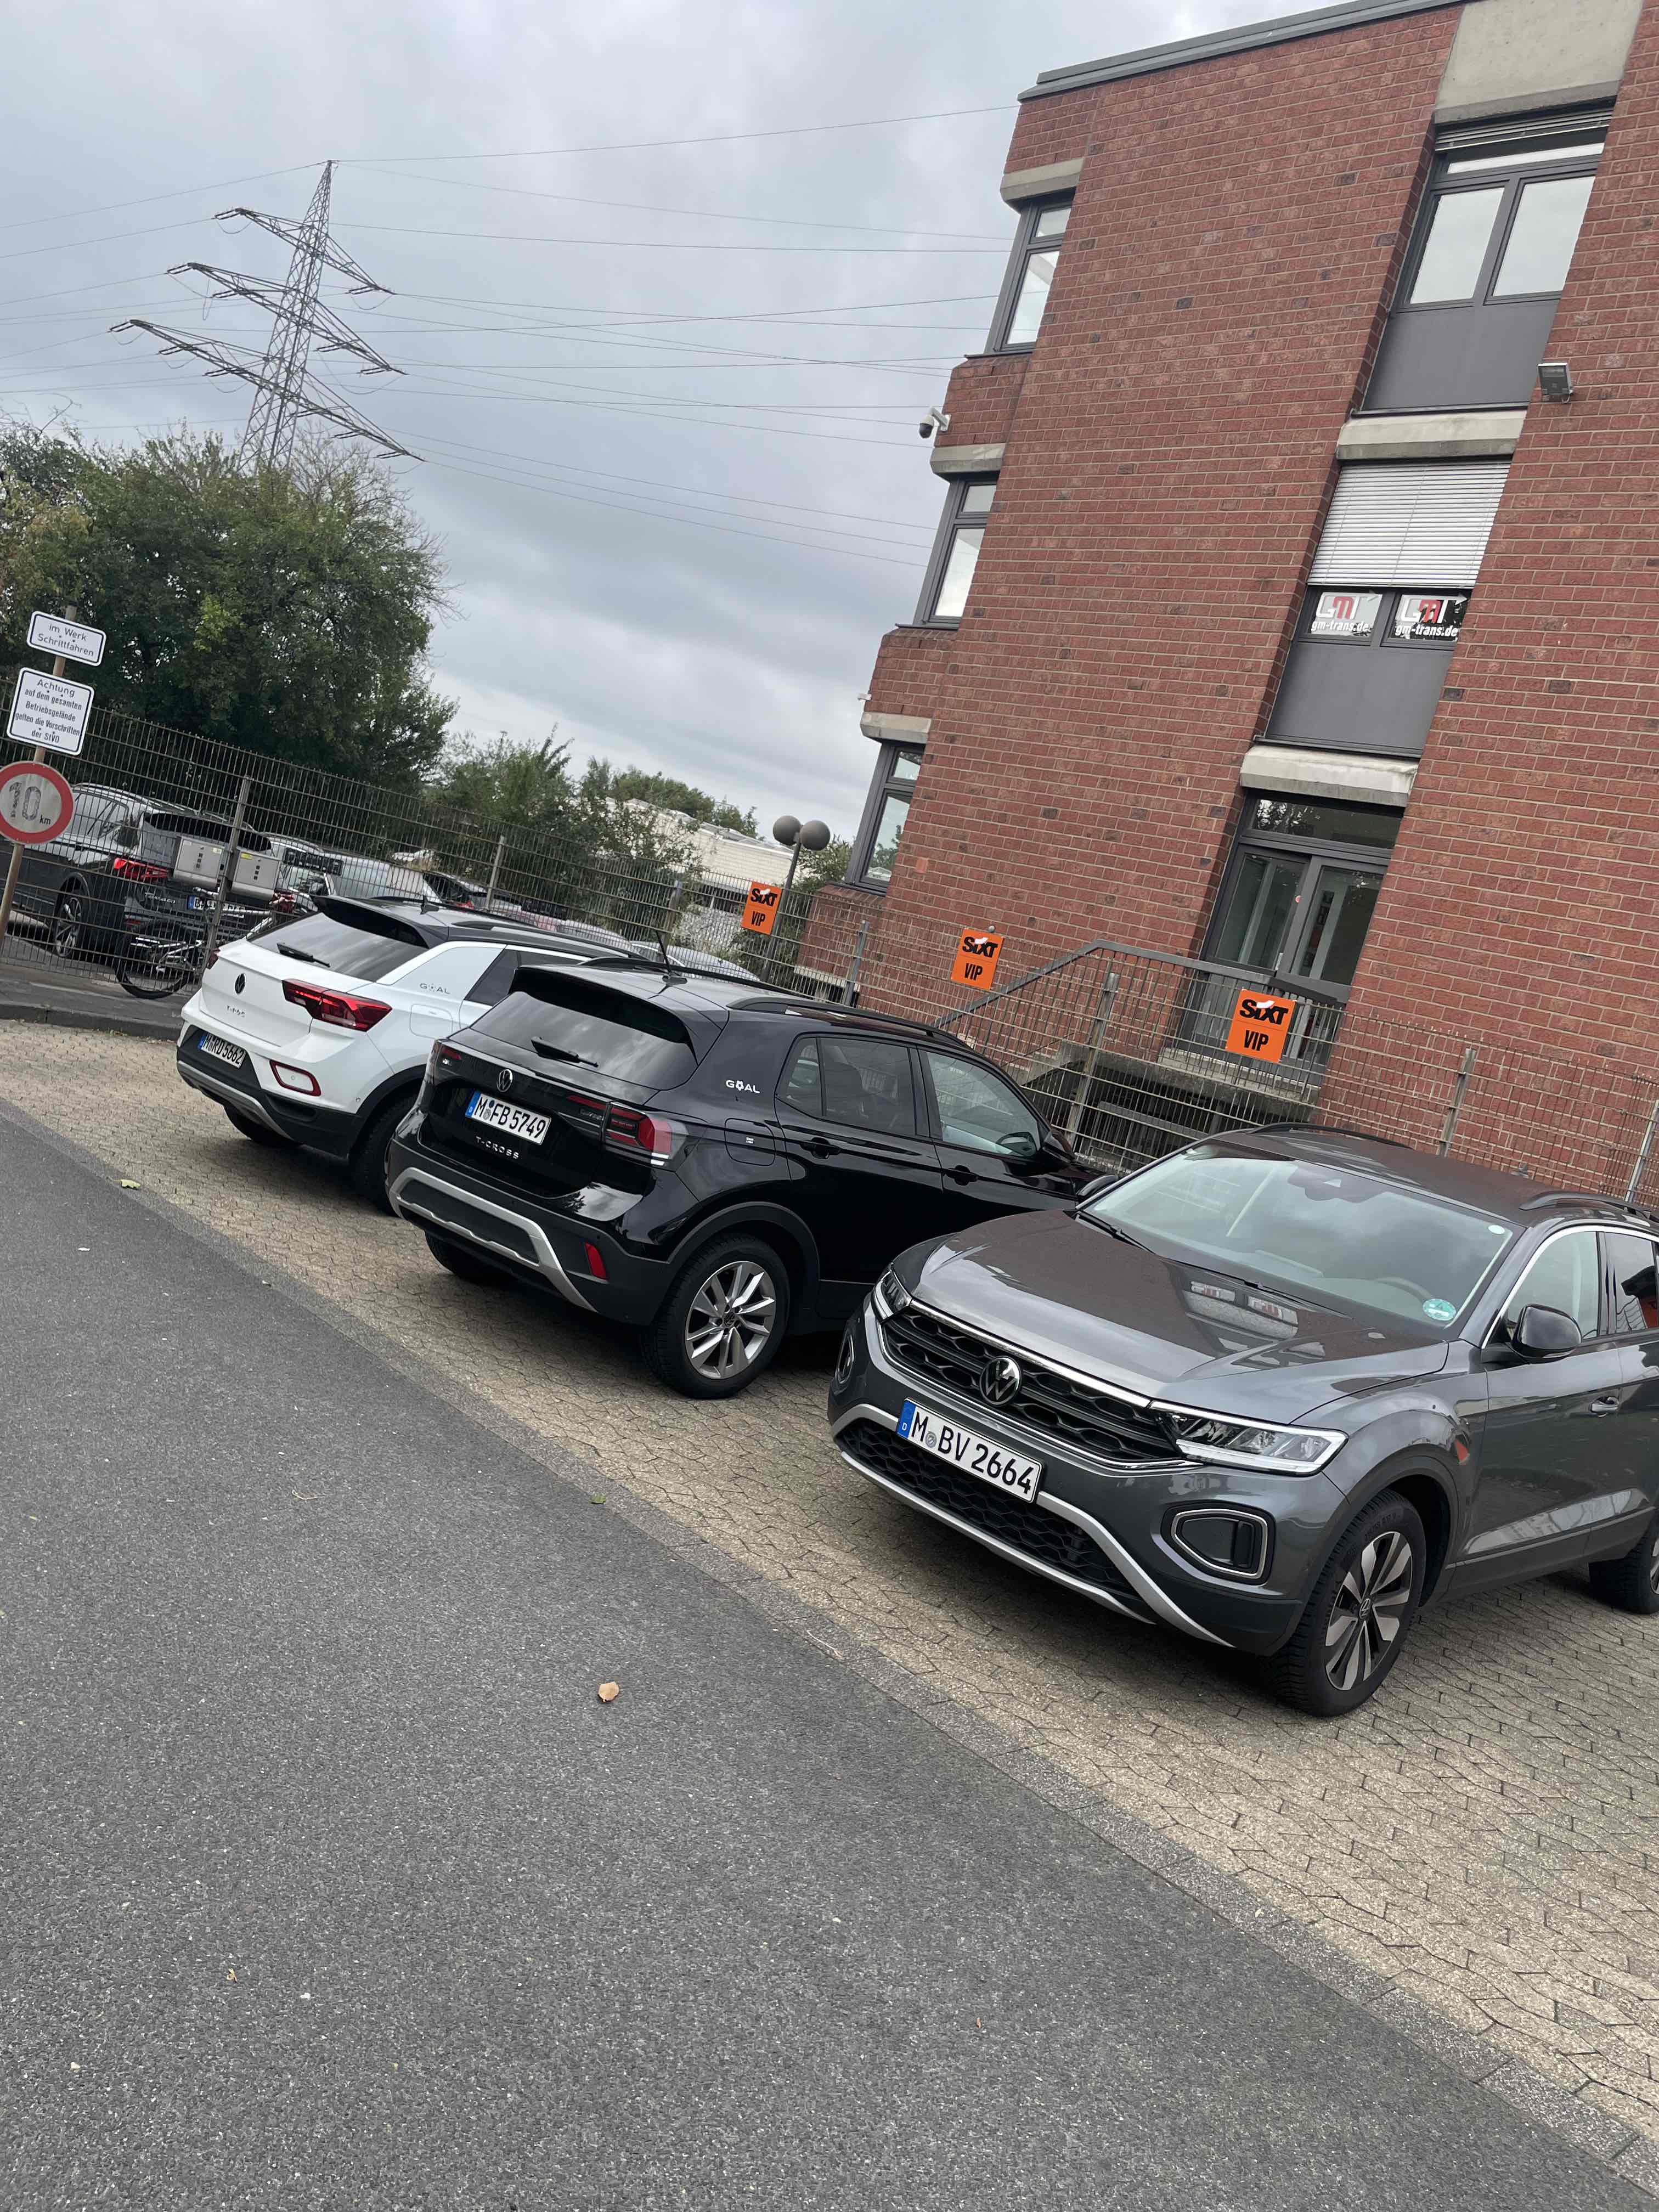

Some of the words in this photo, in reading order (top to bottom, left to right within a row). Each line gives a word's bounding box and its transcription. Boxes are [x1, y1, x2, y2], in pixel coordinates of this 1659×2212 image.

[65, 627, 87, 641] Werk
[1311, 620, 1369, 632] gm-trans.de
[1395, 624, 1458, 637] gm-trans.de
[37, 633, 94, 657] Schrittfahren
[37, 679, 75, 697] Achtung
[25, 689, 36, 697] auf
[36, 692, 50, 701] dem
[52, 697, 82, 710] gesamten
[25, 701, 76, 721] Betriebsgelände
[15, 713, 33, 723] gelten
[35, 717, 44, 726] die
[46, 720, 81, 736] Vorschriften
[31, 730, 42, 738] der
[44, 732, 60, 743] StVO
[9, 782, 42, 821] 10
[40, 815, 51, 825] km
[751, 911, 766, 926] VIP
[964, 963, 983, 980] VIP
[1244, 1030, 1269, 1051] VIP
[222, 1044, 244, 1064] 5662
[726, 1080, 760, 1093] GOAL
[474, 1097, 488, 1118] M
[489, 1103, 511, 1126] FB
[509, 1110, 546, 1138] 5749
[476, 1136, 520, 1159] T-CROSS
[901, 1422, 908, 1431] D
[911, 1411, 929, 1442] M
[937, 1425, 971, 1462] BV
[970, 1443, 1035, 1495] 2664
